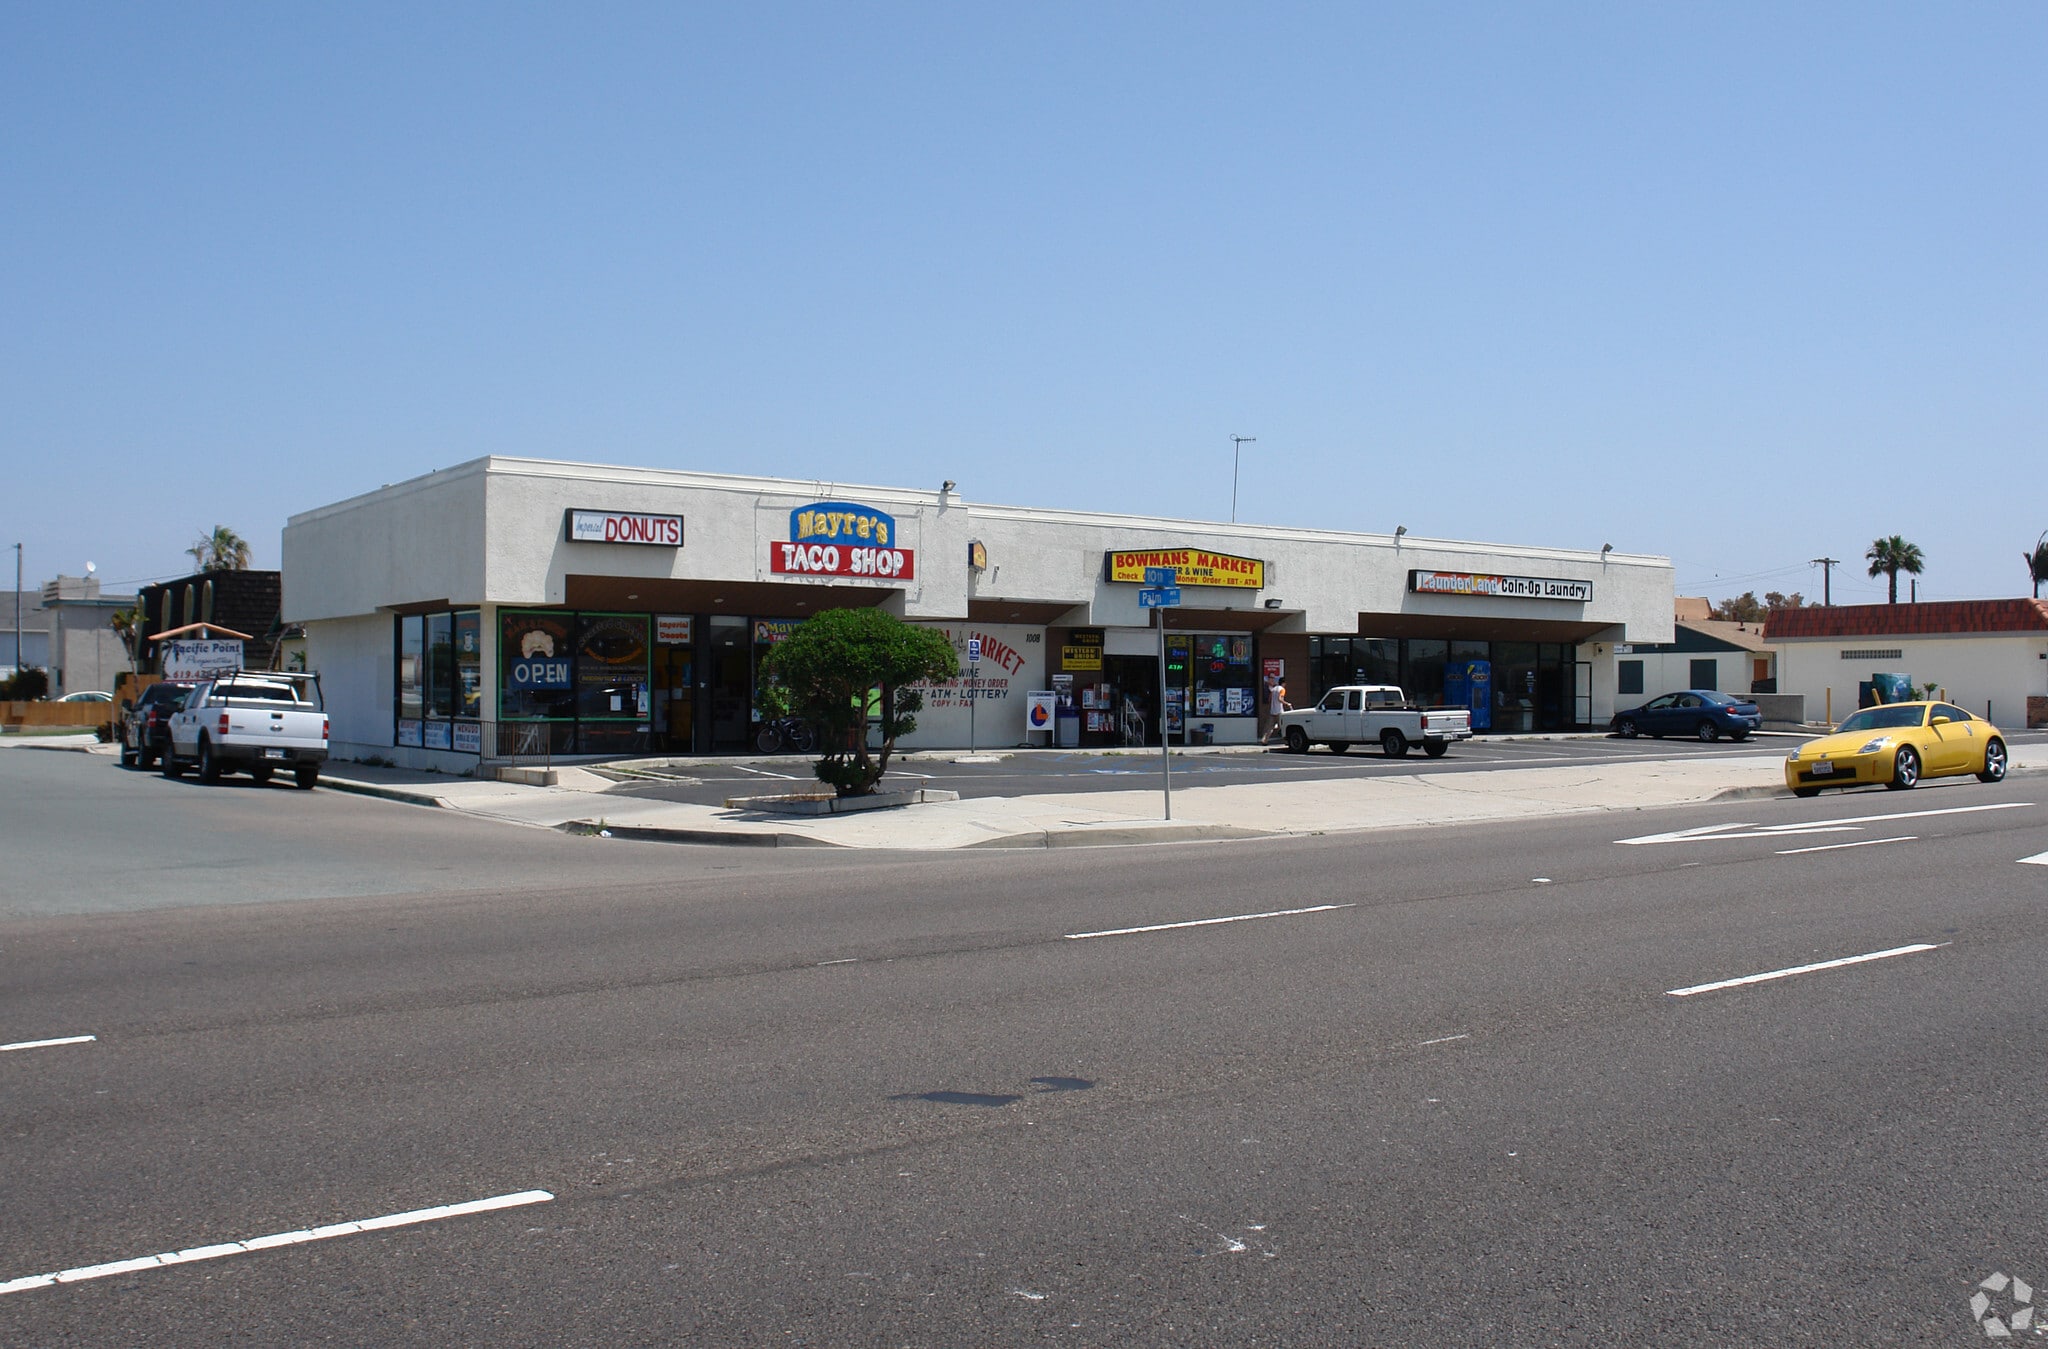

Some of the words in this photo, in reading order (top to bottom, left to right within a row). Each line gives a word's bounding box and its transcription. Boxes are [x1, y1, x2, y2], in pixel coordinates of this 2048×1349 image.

[605, 516, 679, 542] DONUTS
[797, 510, 888, 544] Mayra's
[781, 544, 840, 571] TACO
[851, 547, 904, 577] SHOP
[1116, 552, 1189, 568] BOWMANS
[1197, 553, 1255, 574] MARKET
[1117, 572, 1138, 580] Check
[1192, 567, 1213, 576] WINE
[1176, 575, 1197, 584] Money
[1544, 581, 1587, 599] Laundry
[172, 643, 209, 655] Pacific
[213, 643, 240, 653] Point
[514, 663, 567, 682] OPEN
[904, 679, 926, 688] HECK
[963, 679, 987, 688] MONEY
[988, 679, 1008, 688] ORDER
[931, 689, 951, 699] ATM
[960, 689, 1008, 699] LOTTERY
